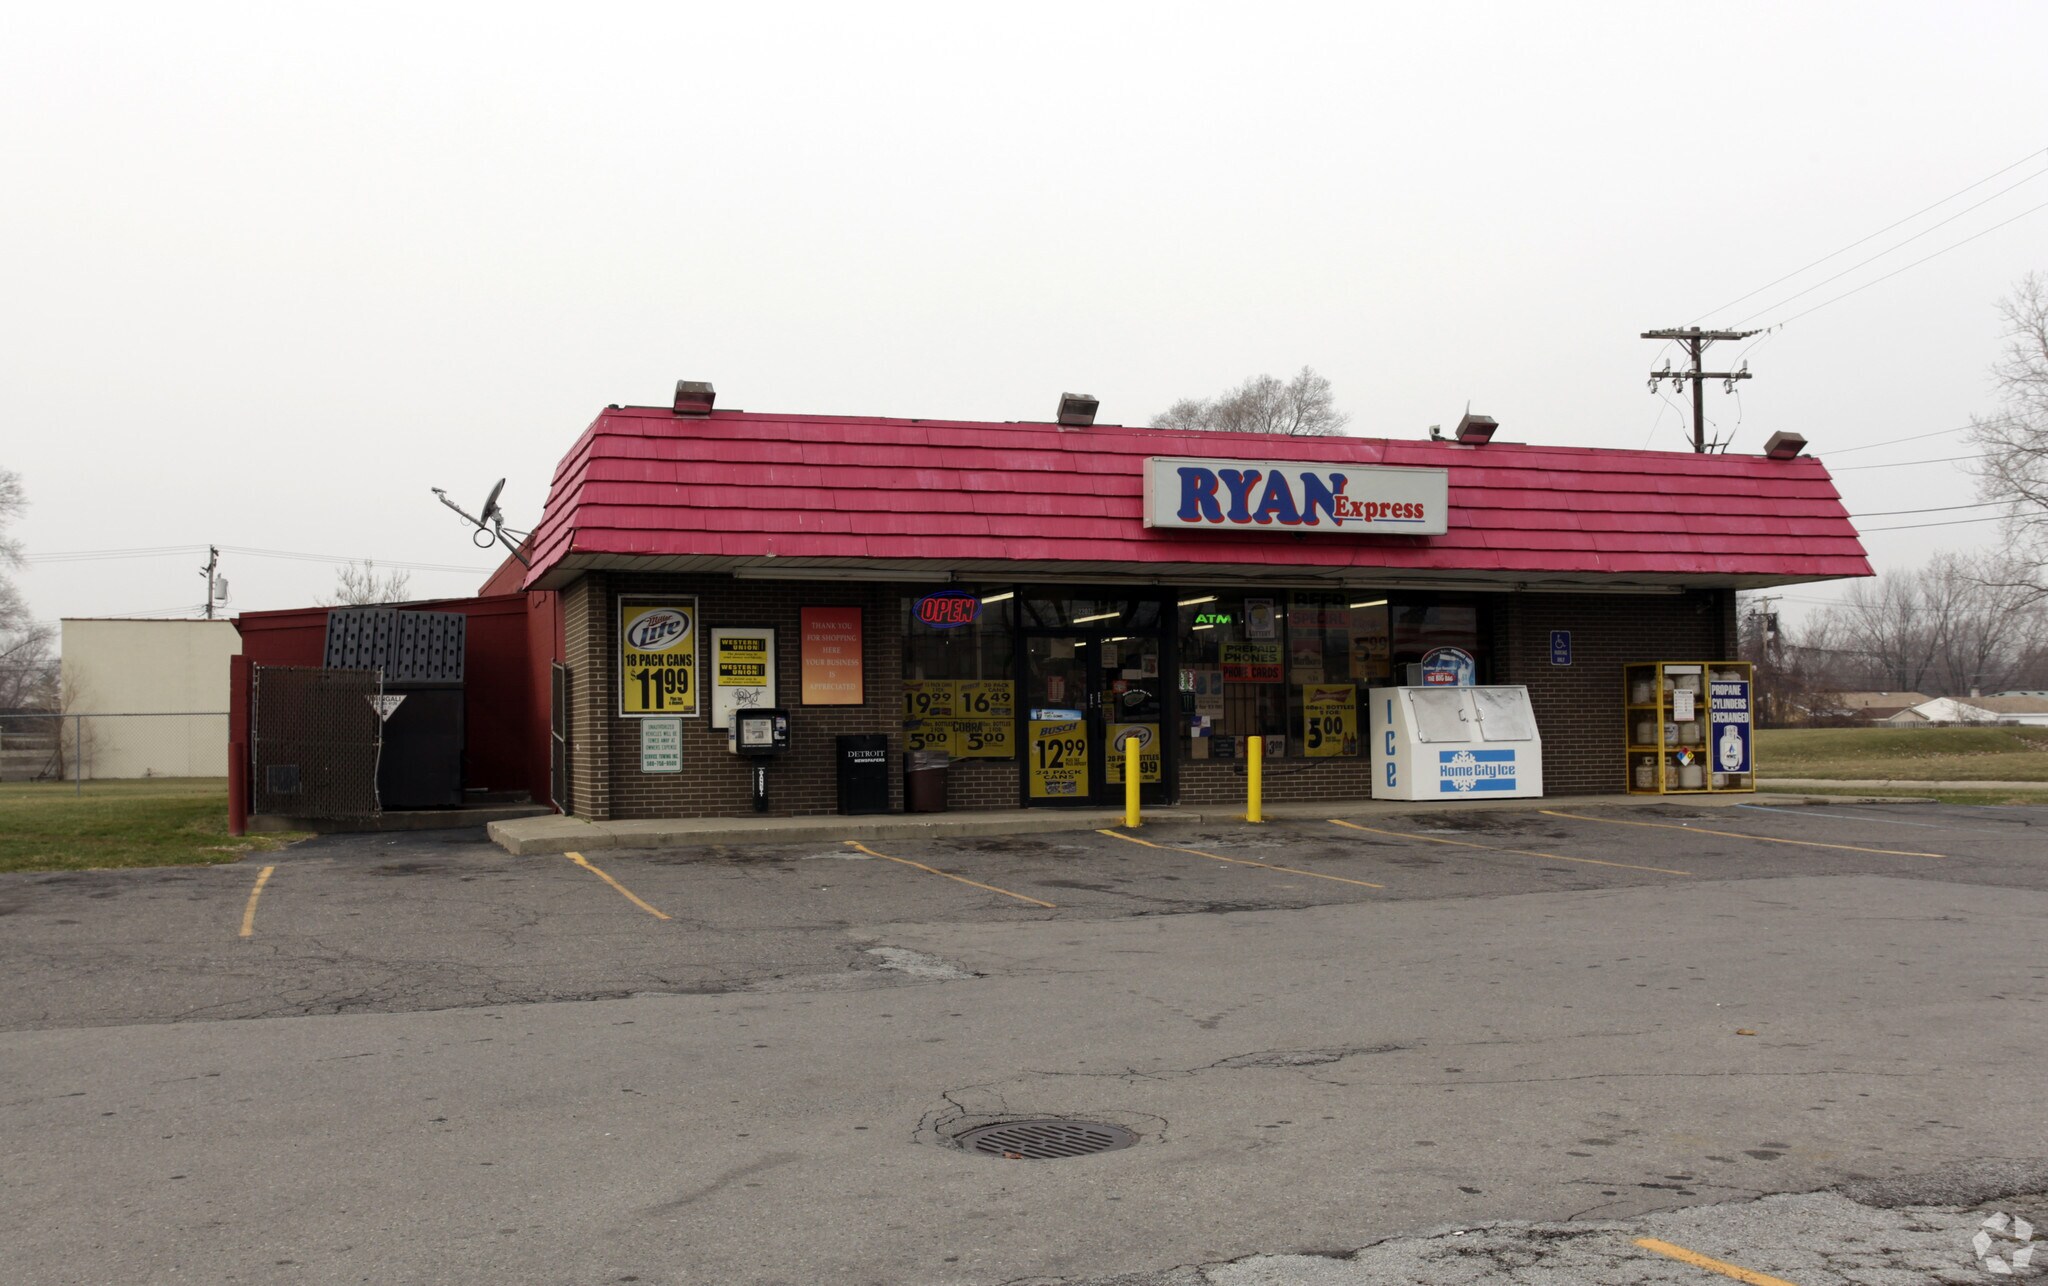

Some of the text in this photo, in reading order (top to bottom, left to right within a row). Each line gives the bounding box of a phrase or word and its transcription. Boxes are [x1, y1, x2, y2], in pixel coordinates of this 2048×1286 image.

[1177, 466, 1347, 526] RYAN
[1335, 496, 1424, 522] Express
[921, 598, 975, 622] OPEN
[647, 615, 672, 627] Miller
[1195, 614, 1232, 624] ATM
[639, 620, 681, 647] Lite
[626, 654, 692, 666] 18 PACK CANS
[806, 658, 859, 666] YOUR BUSINESS
[1224, 653, 1277, 662] PHONES
[1223, 667, 1279, 679] PHONE CARDS
[811, 682, 856, 690] APPRECIATED
[1711, 684, 1742, 695] PROPANE
[1711, 698, 1747, 709] CYLINDERS
[1712, 712, 1749, 723] EXCHANGED
[953, 721, 984, 732] COBRA
[1040, 722, 1077, 736] BUSCH
[847, 750, 885, 758] DETROIT
[1440, 764, 1516, 778] Home City Ice
